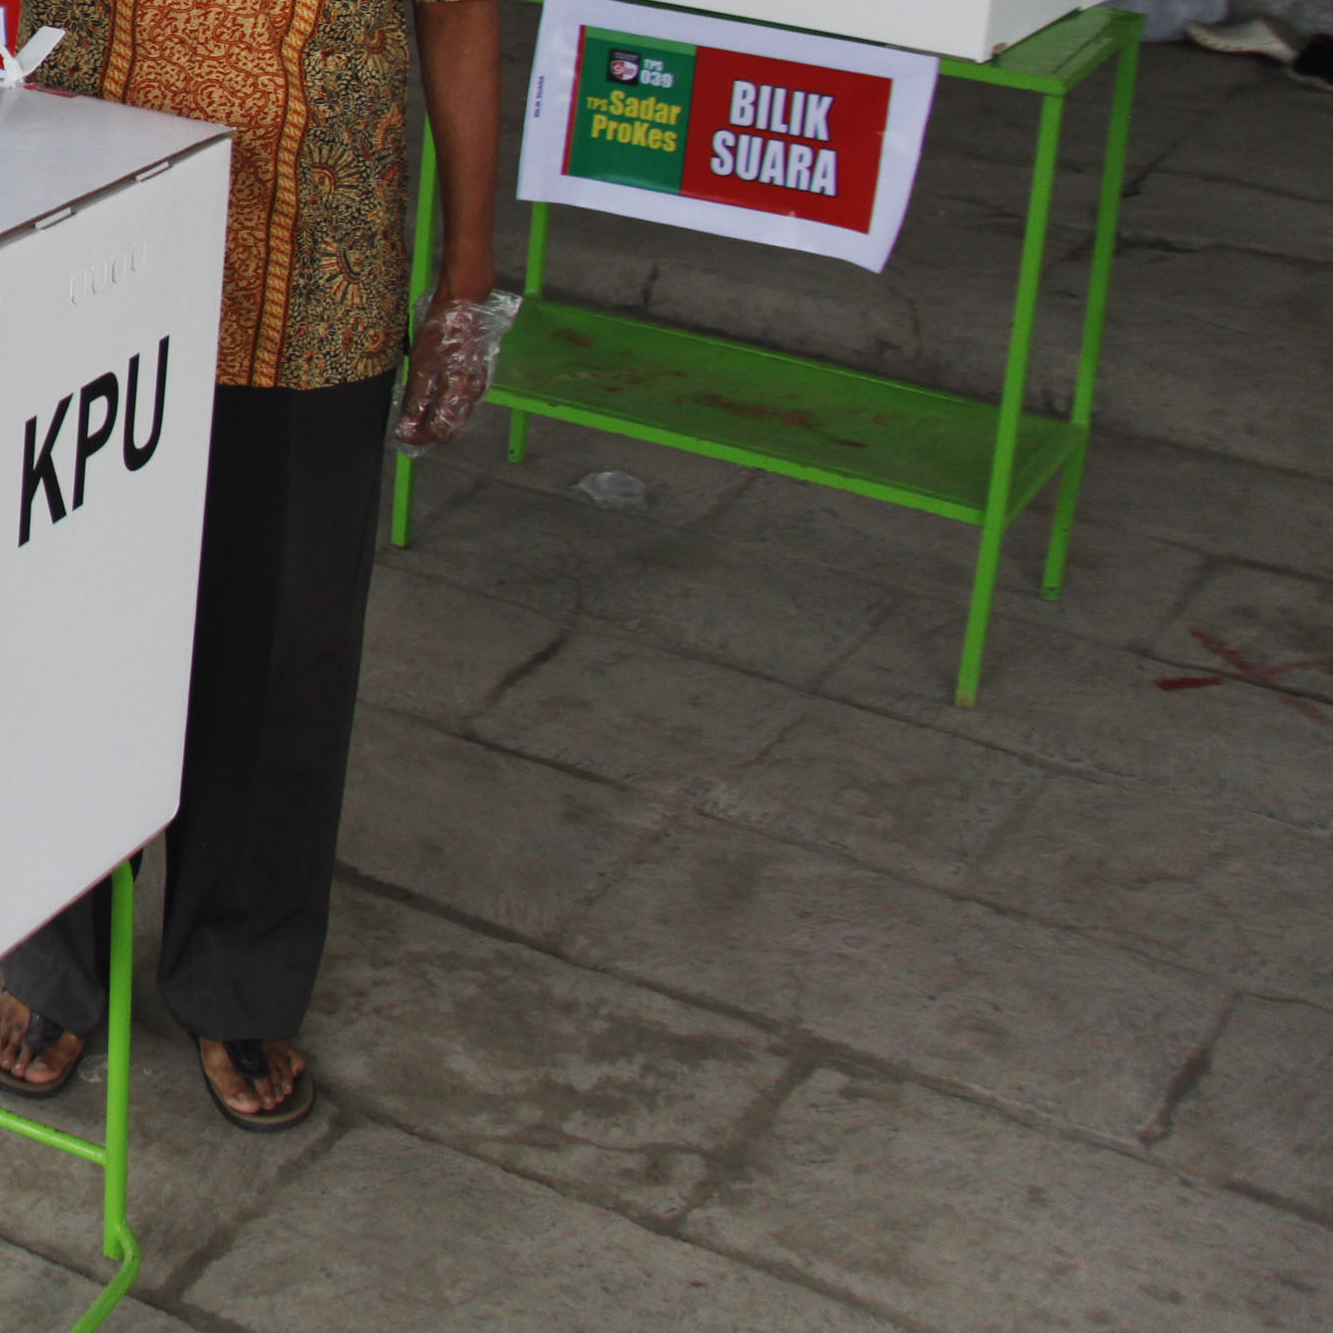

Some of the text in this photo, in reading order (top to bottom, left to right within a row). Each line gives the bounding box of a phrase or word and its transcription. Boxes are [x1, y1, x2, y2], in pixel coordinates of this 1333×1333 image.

[640, 71, 675, 89] 039
[643, 58, 664, 72] TPS
[587, 90, 682, 126] TPS Sadar
[729, 79, 834, 142] BILIK
[590, 113, 678, 153] ProKes
[710, 130, 839, 199] SUARA
[18, 334, 170, 549] KPU
